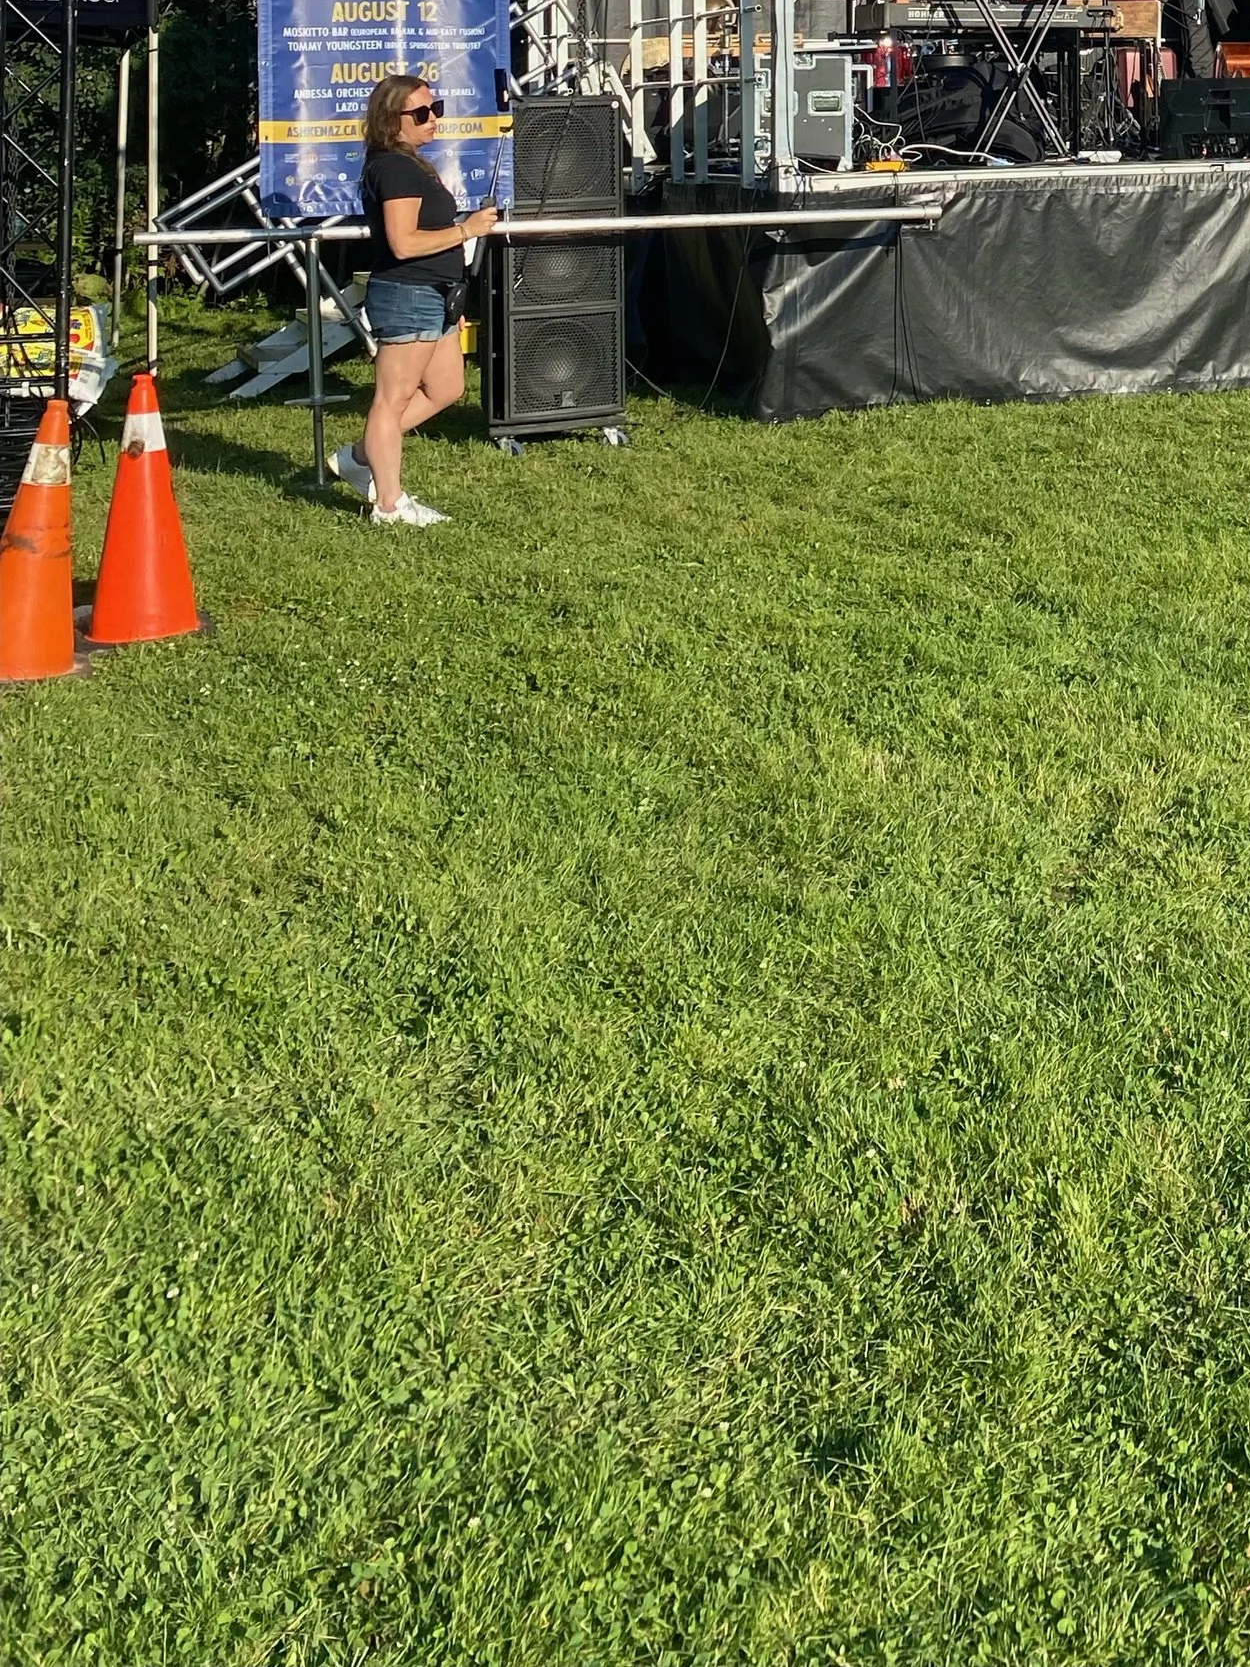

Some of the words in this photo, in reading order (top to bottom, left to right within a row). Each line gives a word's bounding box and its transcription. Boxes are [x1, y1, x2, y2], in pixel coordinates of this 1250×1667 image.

[332, 1, 409, 22] AUGUST
[417, 1, 438, 22] 12
[283, 27, 330, 37] MOSKITTO
[332, 27, 349, 37] BAR
[418, 28, 424, 36] &
[288, 41, 322, 51] TOMMY
[326, 40, 383, 51] YOUNGSTEEN
[331, 62, 409, 84] AUGUST
[417, 62, 440, 83] 26
[335, 102, 359, 113] LAZO
